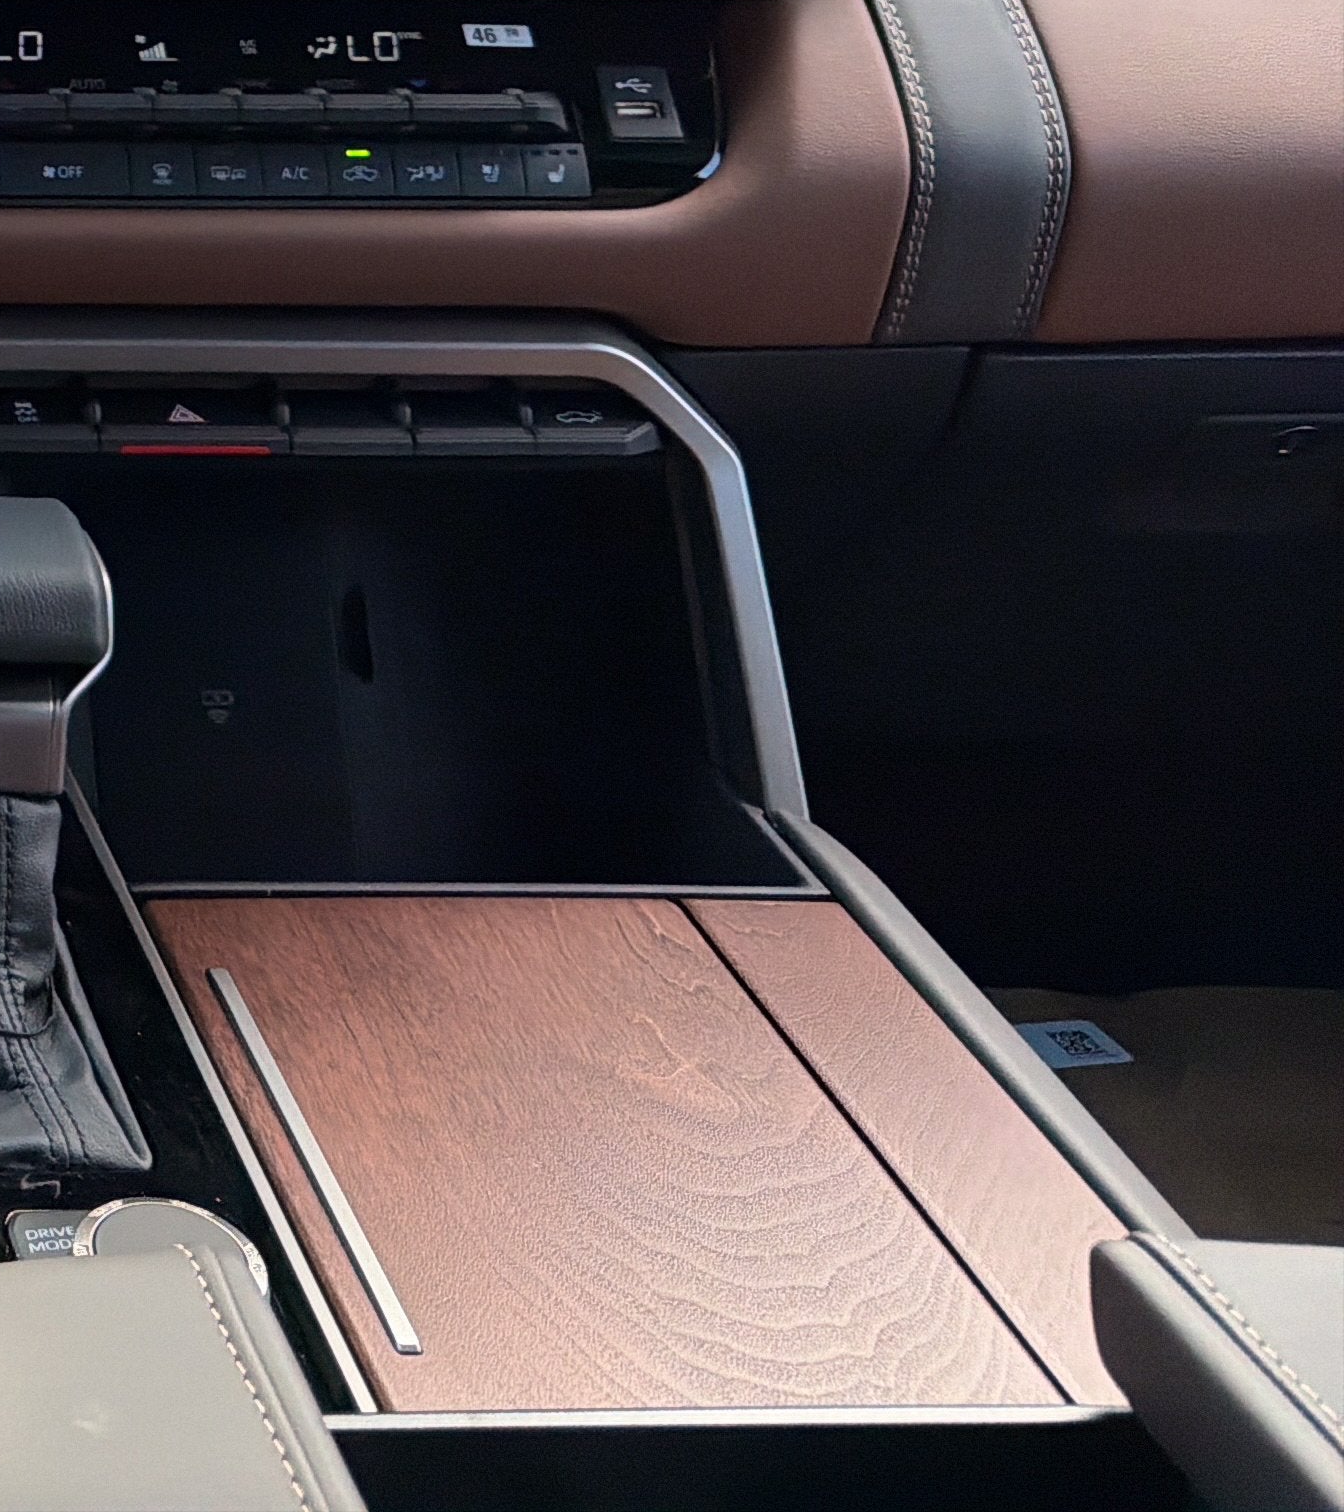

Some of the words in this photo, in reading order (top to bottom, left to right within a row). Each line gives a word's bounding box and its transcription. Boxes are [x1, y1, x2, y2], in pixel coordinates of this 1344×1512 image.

[472, 27, 498, 44] 46
[346, 31, 400, 62] LO
[57, 166, 84, 178] OFF
[281, 166, 309, 180] A/C
[24, 1225, 76, 1241] DRIVE
[28, 1238, 74, 1255] MOD
